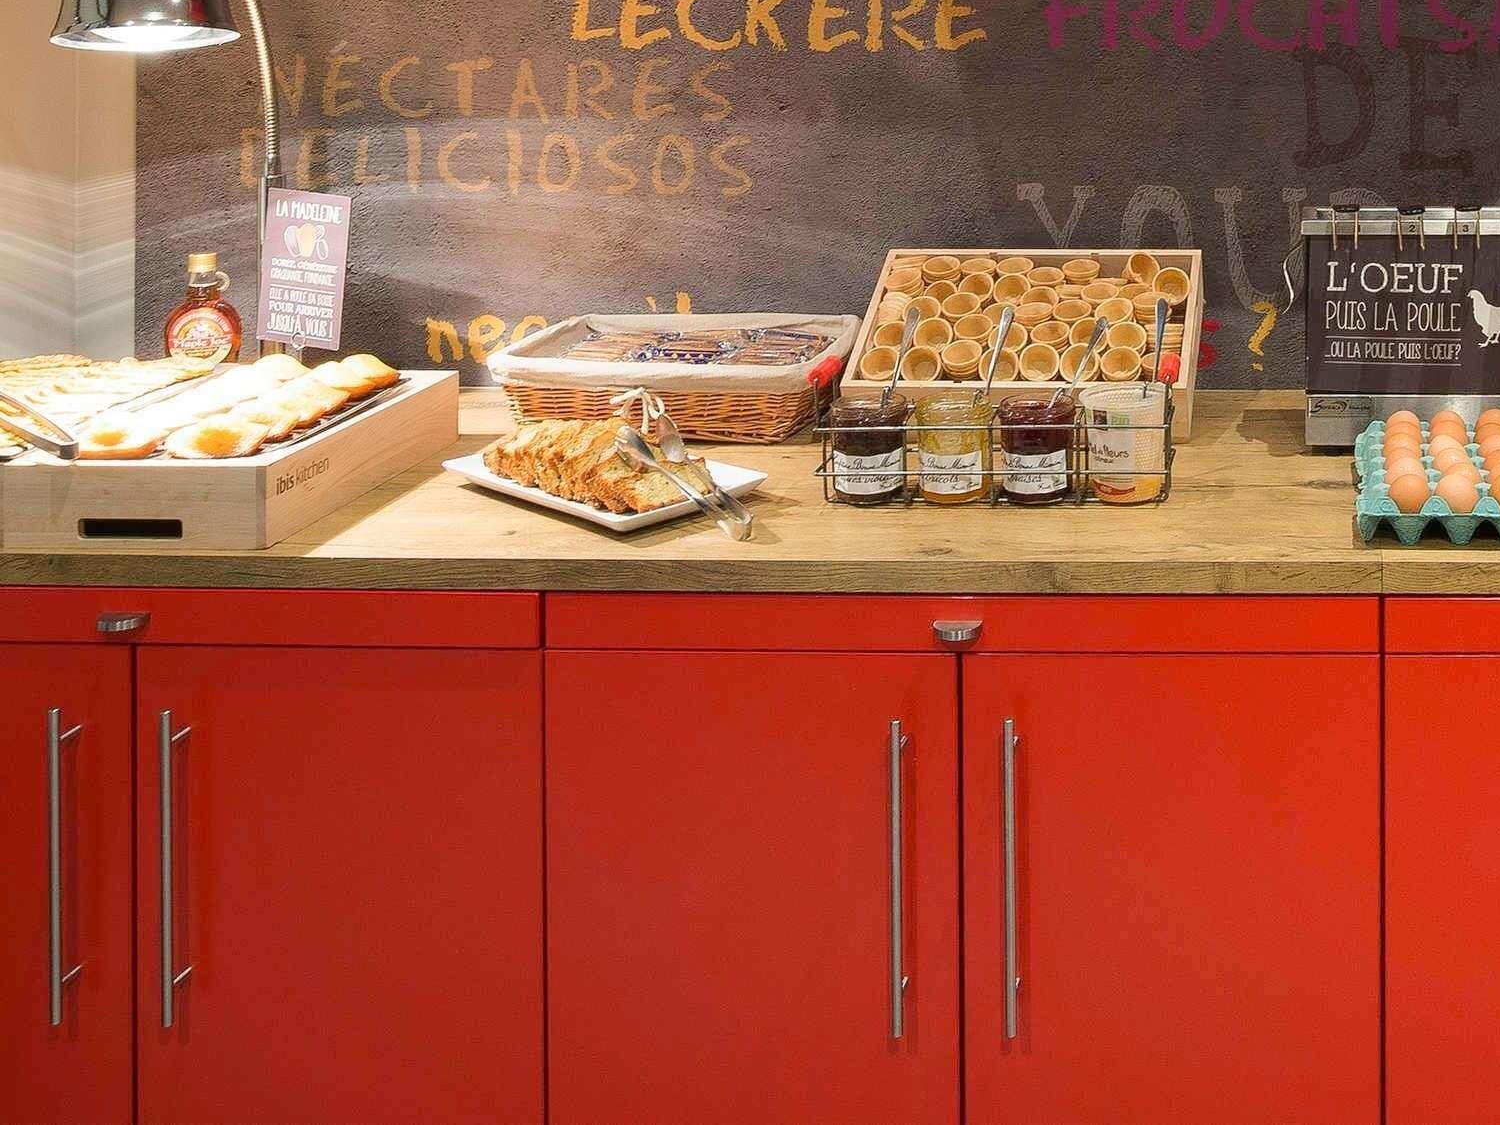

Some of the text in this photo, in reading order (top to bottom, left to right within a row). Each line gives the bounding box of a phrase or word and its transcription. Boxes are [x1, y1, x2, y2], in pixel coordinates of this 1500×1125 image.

[276, 200, 343, 224] LA MADELEINE
[1326, 261, 1463, 293] L'OEUF
[1325, 300, 1462, 333] PUIS LA POULE
[1346, 343, 1361, 359] LA
[1365, 343, 1395, 360] POULE
[1398, 343, 1421, 361] PUIS
[276, 474, 295, 496] ibis
